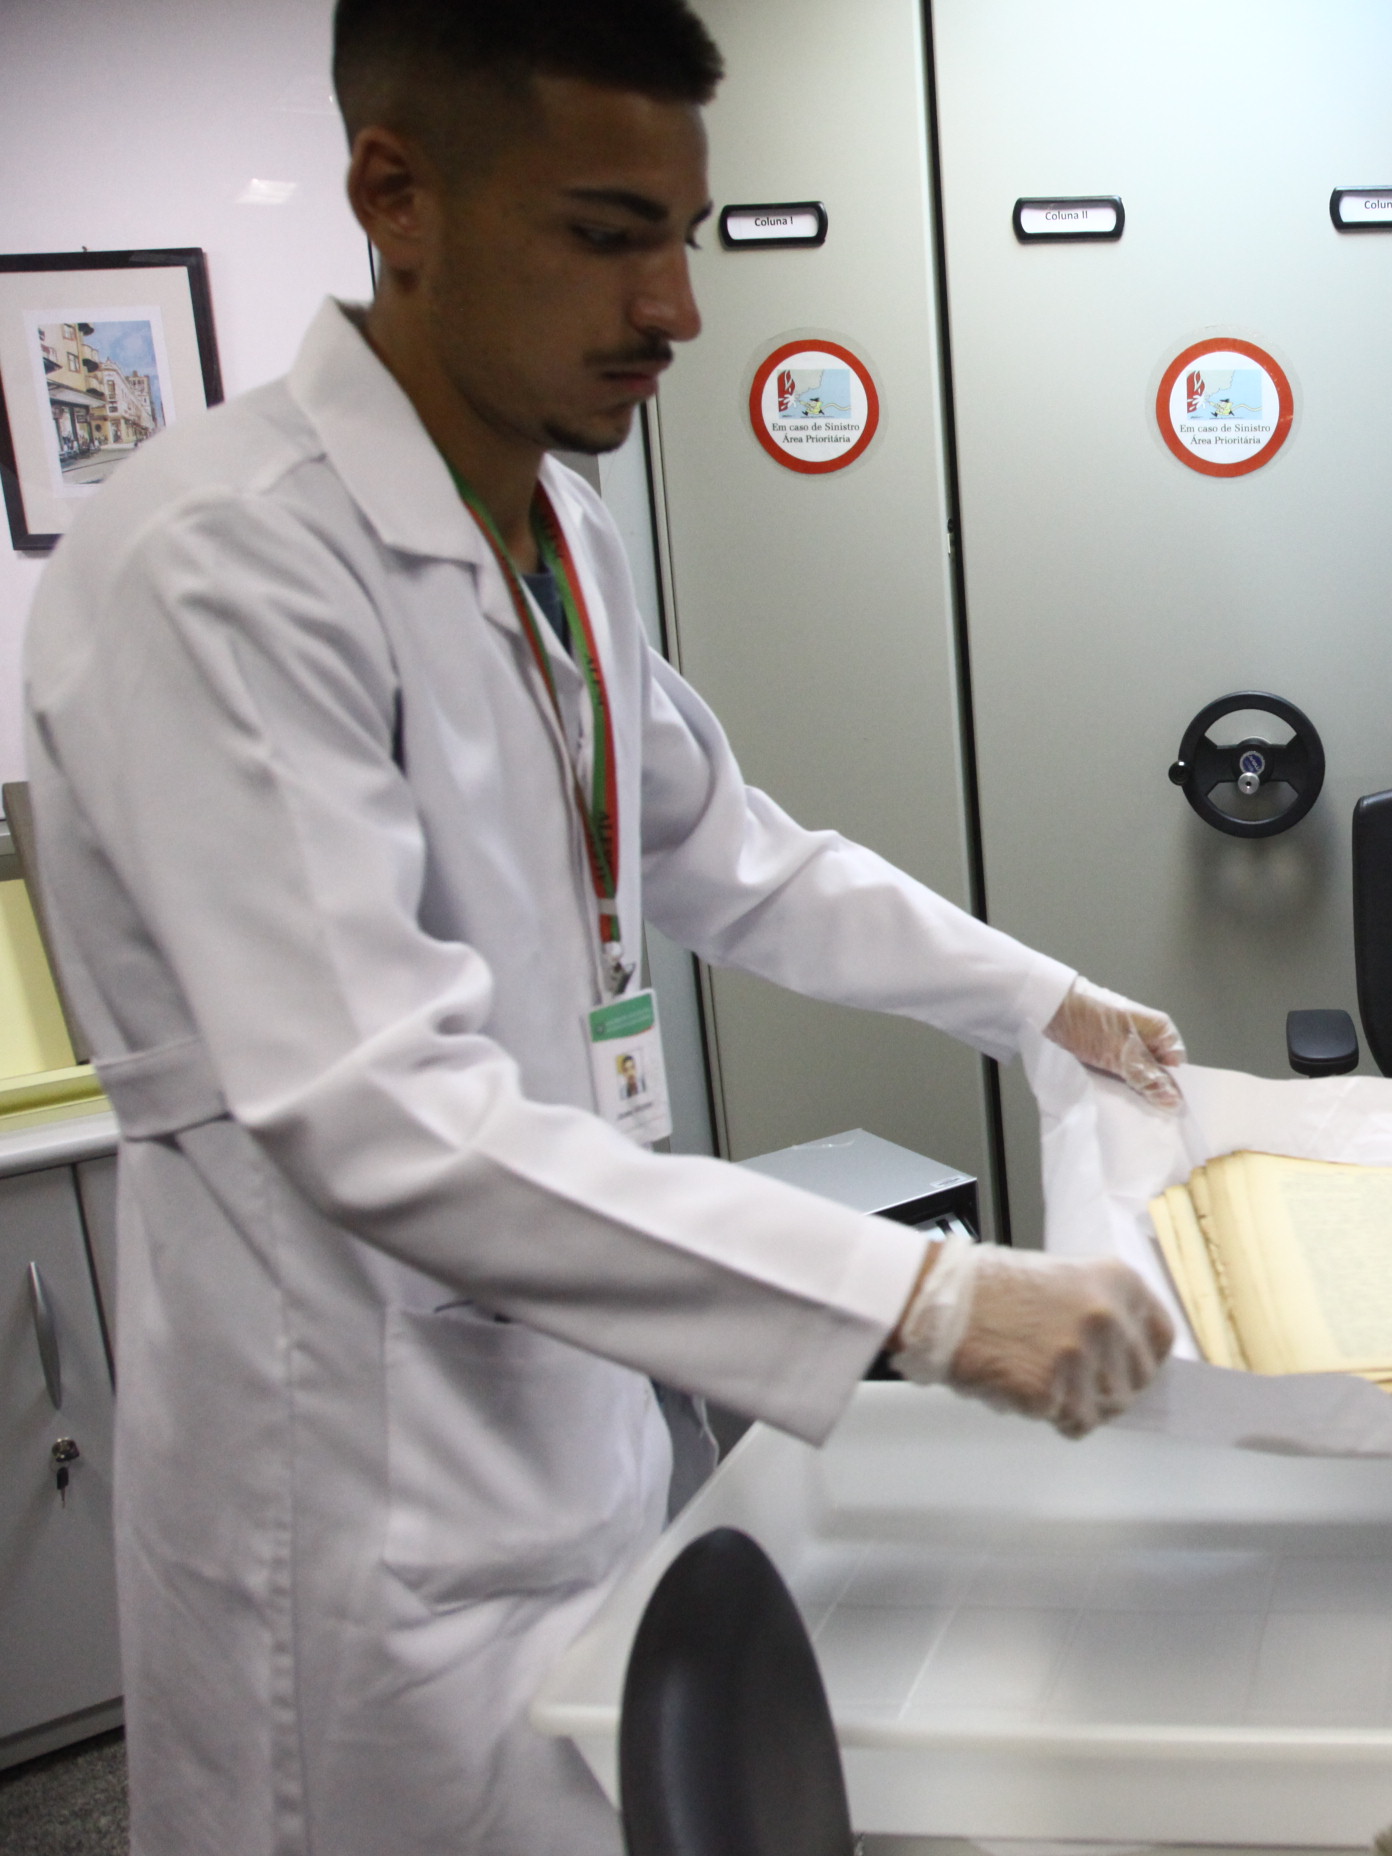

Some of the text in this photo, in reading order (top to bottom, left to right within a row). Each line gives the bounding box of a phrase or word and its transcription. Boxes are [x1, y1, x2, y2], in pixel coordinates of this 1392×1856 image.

[1045, 211, 1078, 221] Coluna
[754, 217, 787, 227] Coluna
[772, 423, 787, 431] Em
[812, 423, 822, 431] de
[825, 422, 860, 431] Sinistro
[1180, 424, 1195, 432] Em
[1221, 423, 1231, 432] de
[1234, 423, 1271, 432] Sinistro
[782, 433, 851, 443] Área Prioritária
[1191, 434, 1261, 444] Área Prioritária
